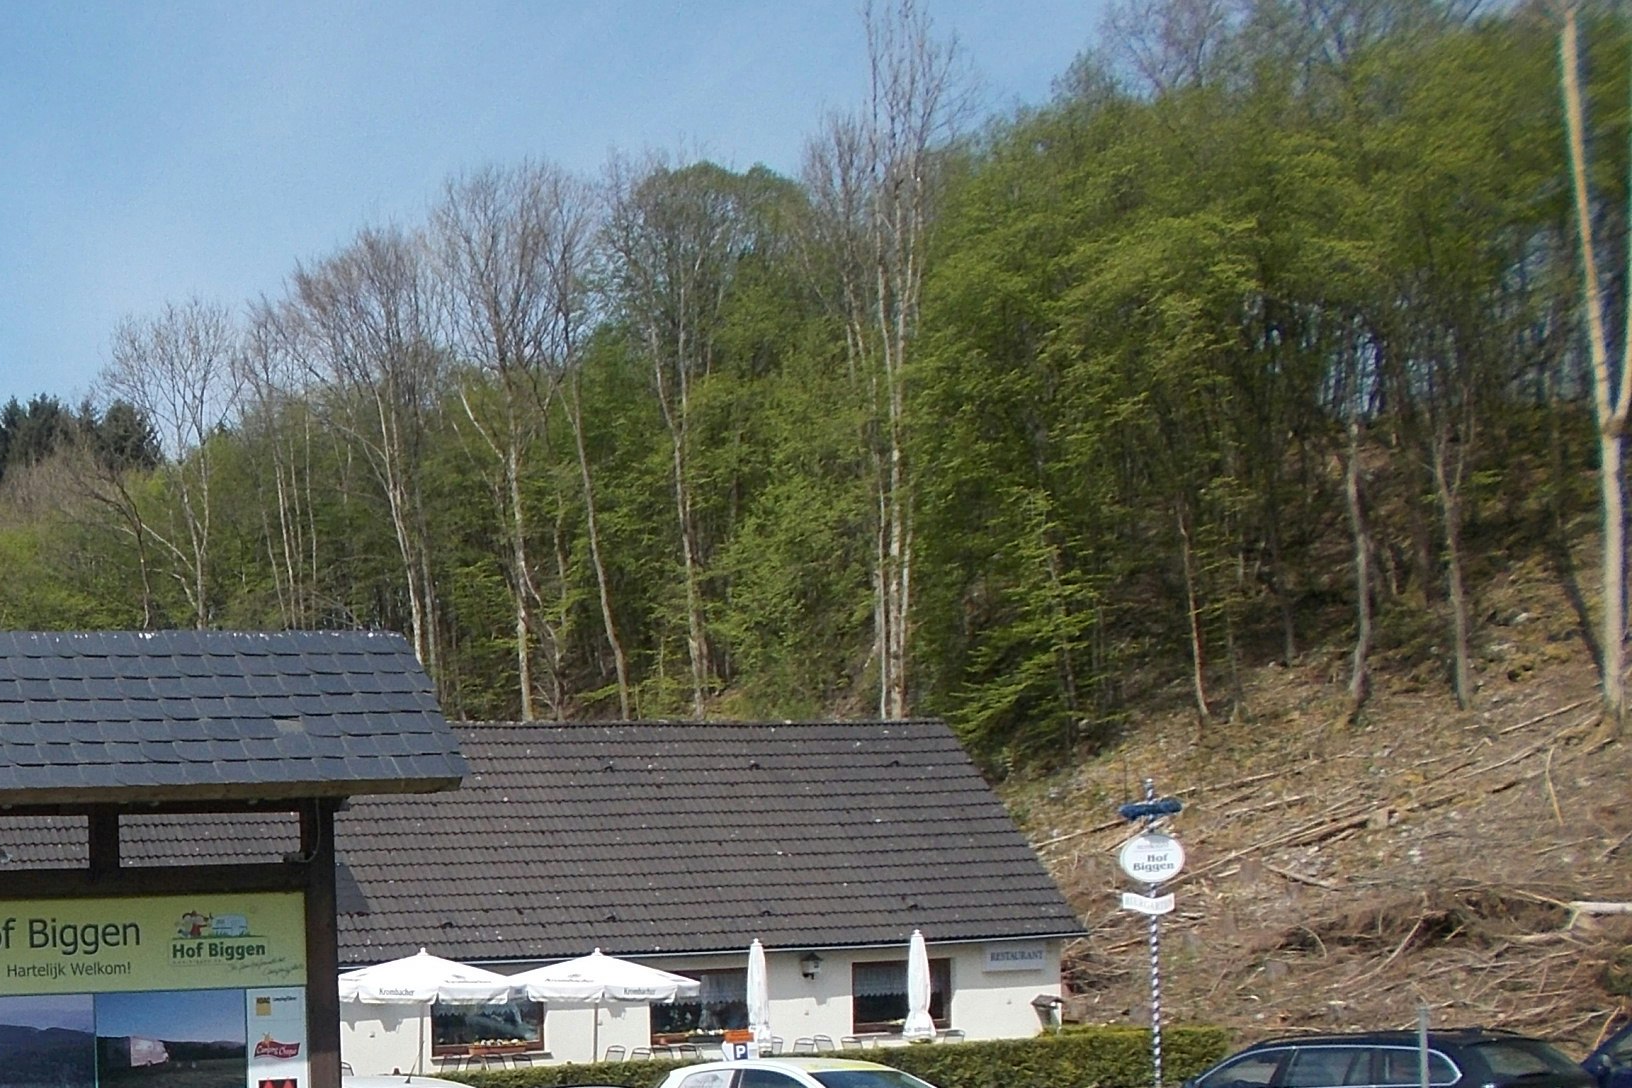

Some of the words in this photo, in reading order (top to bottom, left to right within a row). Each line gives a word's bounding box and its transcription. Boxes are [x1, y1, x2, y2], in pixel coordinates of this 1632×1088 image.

[1147, 853, 1168, 862] Hof
[1133, 861, 1174, 872] Biggen
[28, 917, 141, 956] Biggen
[172, 942, 204, 959] Hof
[208, 941, 266, 961] Biggen
[990, 950, 1043, 962] RESTAURANT
[7, 961, 66, 980] Hartelijk
[71, 961, 132, 977] Welkom!
[379, 987, 415, 996] Krombacher
